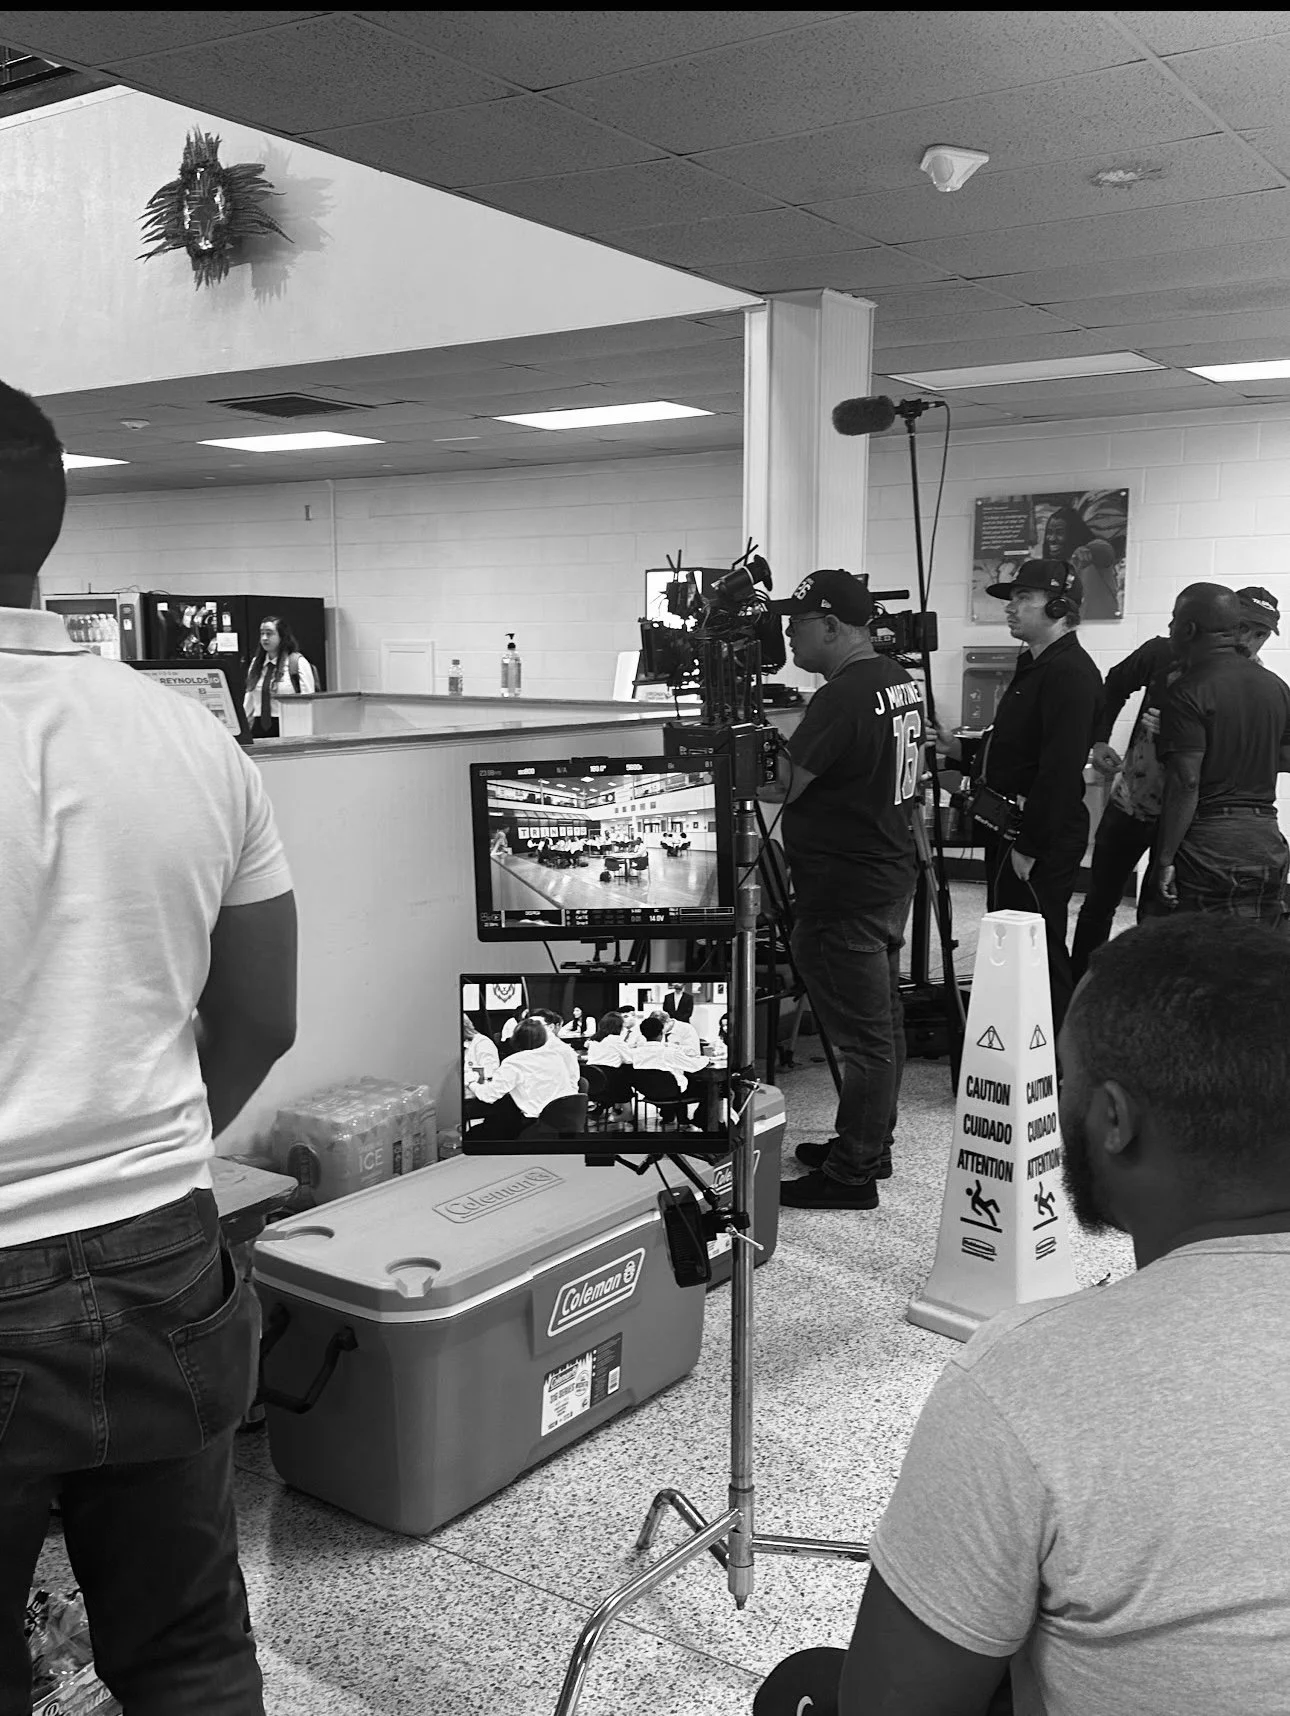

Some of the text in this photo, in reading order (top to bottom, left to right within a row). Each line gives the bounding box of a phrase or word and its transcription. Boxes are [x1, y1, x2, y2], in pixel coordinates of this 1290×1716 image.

[875, 691, 885, 715] J
[893, 710, 922, 805] 16
[966, 1075, 1011, 1106] CAUTION
[1026, 1074, 1053, 1105] CAUTION
[963, 1113, 1013, 1145] CUIDADO
[1027, 1111, 1057, 1143] CUIDADO
[358, 1148, 384, 1174] ICE
[713, 1167, 733, 1186] Cole
[957, 1148, 1014, 1183] ATTENTION
[1026, 1147, 1061, 1181] ATTENTION
[444, 1180, 537, 1215] Coleman
[561, 1272, 622, 1317] Coleman
